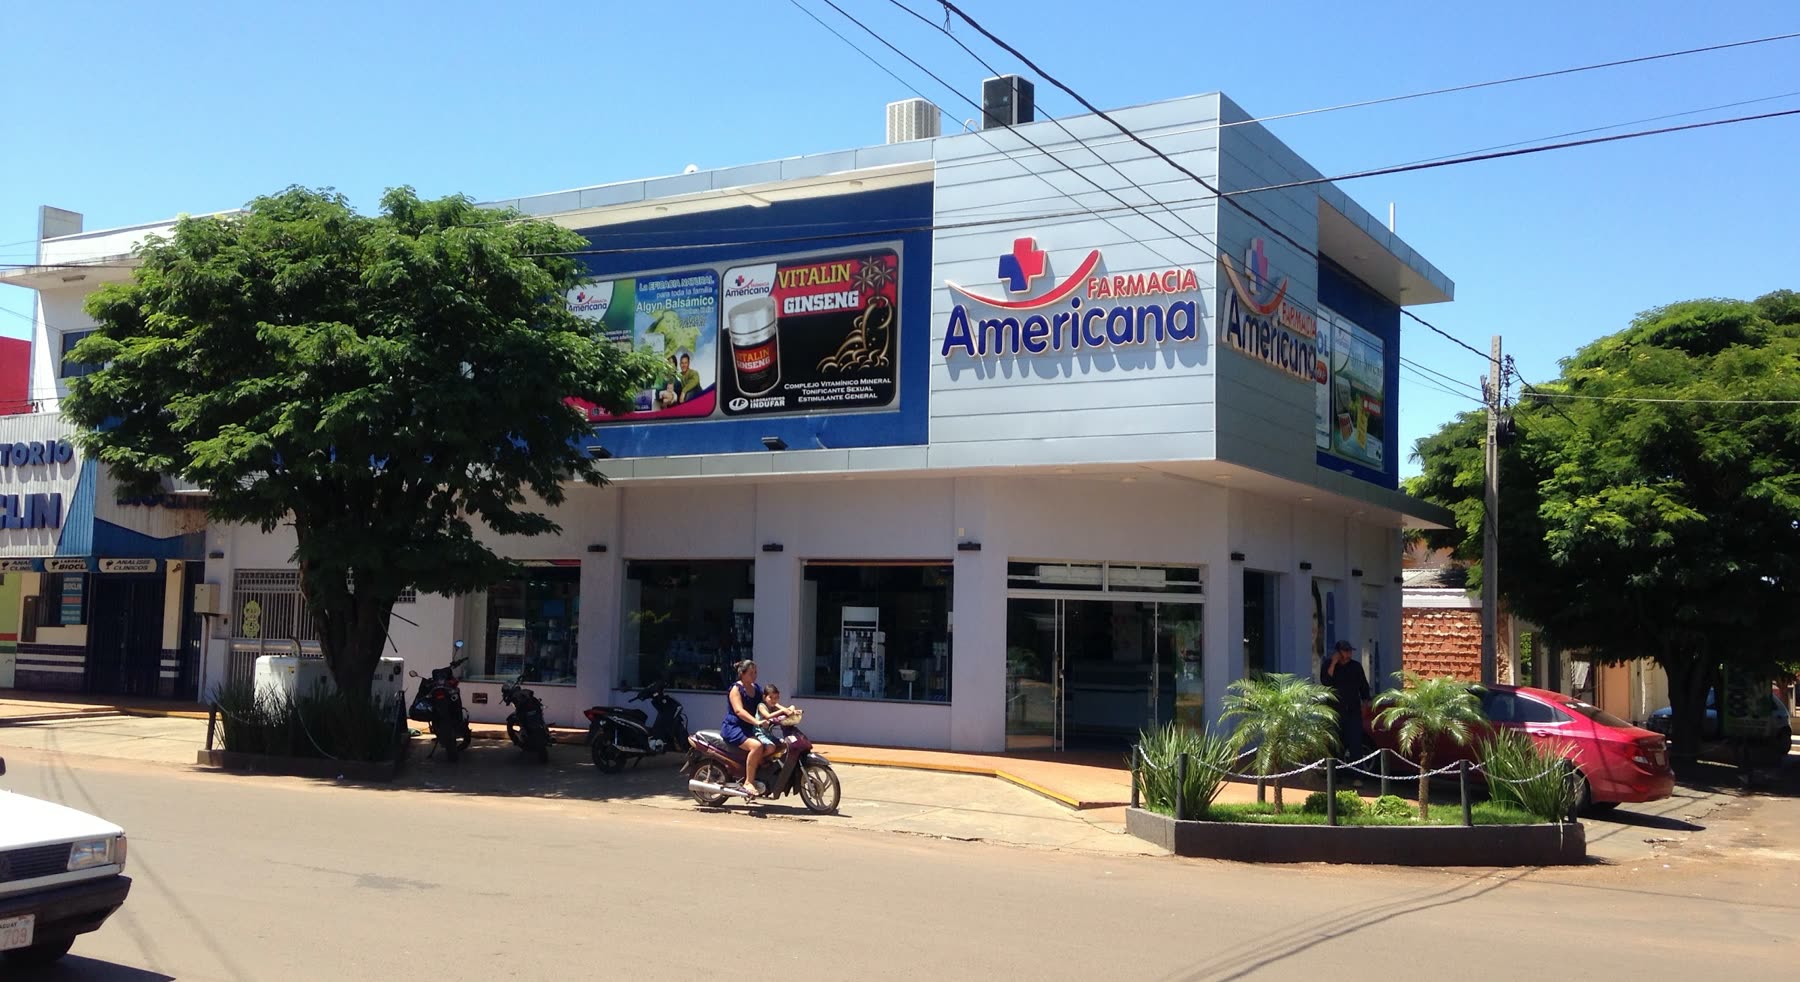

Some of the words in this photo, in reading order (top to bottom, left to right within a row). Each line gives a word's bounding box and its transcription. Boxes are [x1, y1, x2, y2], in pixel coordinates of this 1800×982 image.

[778, 263, 851, 289] VITALIN
[1087, 268, 1197, 299] FARMACIA
[657, 291, 670, 299] para
[671, 288, 685, 297] toda
[686, 287, 691, 295] la
[692, 286, 713, 294] familia
[725, 285, 770, 298] Americana
[568, 302, 608, 311] Americana
[636, 302, 663, 314] Algyn
[665, 295, 715, 310] Balsámico
[784, 291, 859, 314] GINSENG
[941, 297, 1197, 357] Americana
[1222, 288, 1318, 380] Americana
[750, 401, 785, 409] INDUFAR
[4, 928, 27, 947] 709
